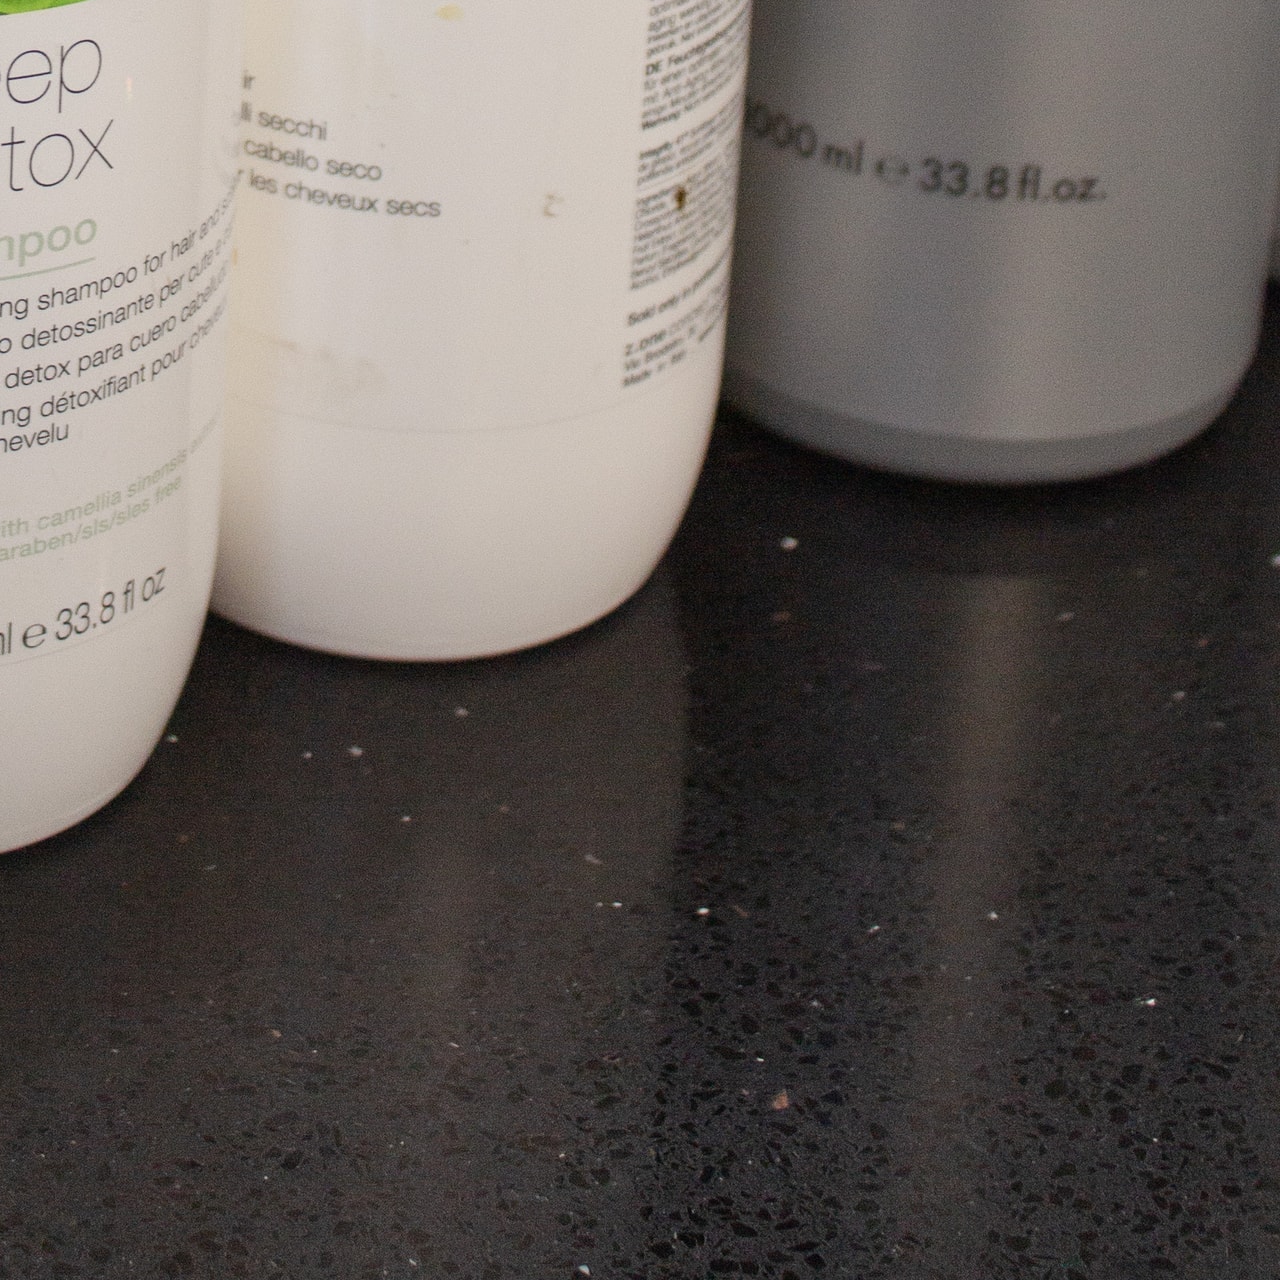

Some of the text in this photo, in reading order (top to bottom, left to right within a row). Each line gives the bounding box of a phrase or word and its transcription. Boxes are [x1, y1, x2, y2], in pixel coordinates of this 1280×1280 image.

[257, 110, 328, 141] secchi
[284, 181, 379, 213] cheveux
[386, 198, 442, 218] secs
[326, 159, 383, 182] seco
[822, 140, 864, 176] ml
[919, 157, 1011, 201] 33.8
[37, 266, 138, 311] shampoo
[143, 251, 167, 276] for
[170, 229, 197, 261] hair
[21, 292, 155, 350] detossinante
[158, 273, 185, 309] per
[4, 359, 71, 389] detox
[77, 342, 124, 378] para
[129, 315, 177, 353] cuero
[40, 363, 147, 417] détoxifiant
[151, 340, 187, 382] pour
[37, 488, 122, 531] camellia
[55, 590, 116, 640] 33.8
[122, 579, 136, 613] fl
[141, 567, 166, 602] oz
